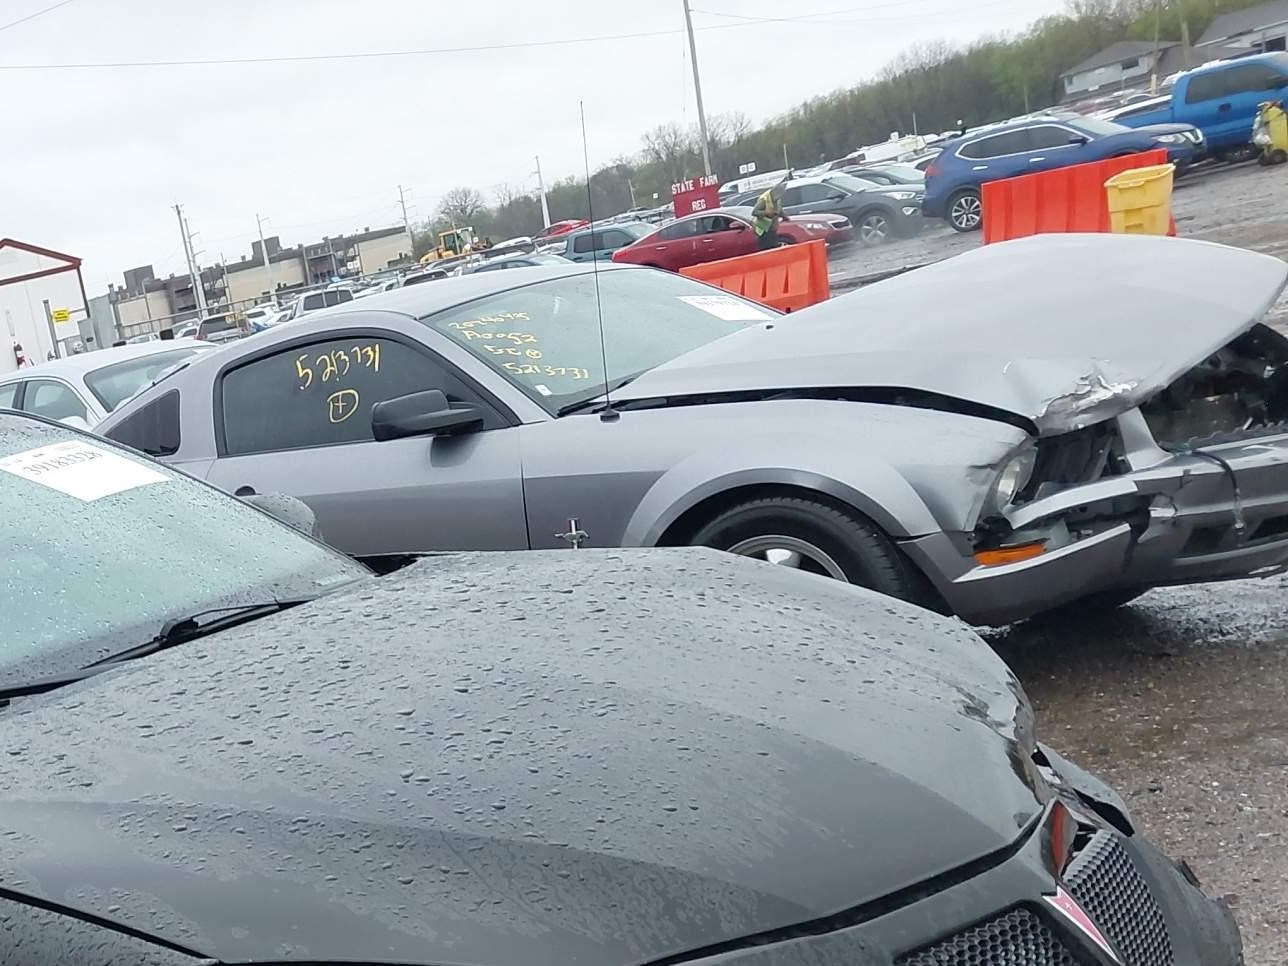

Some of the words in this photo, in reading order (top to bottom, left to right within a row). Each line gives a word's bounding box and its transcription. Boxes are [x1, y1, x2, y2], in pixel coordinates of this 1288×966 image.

[672, 180, 694, 195] STATE
[700, 174, 718, 188] FARM
[502, 362, 590, 380] 5213731
